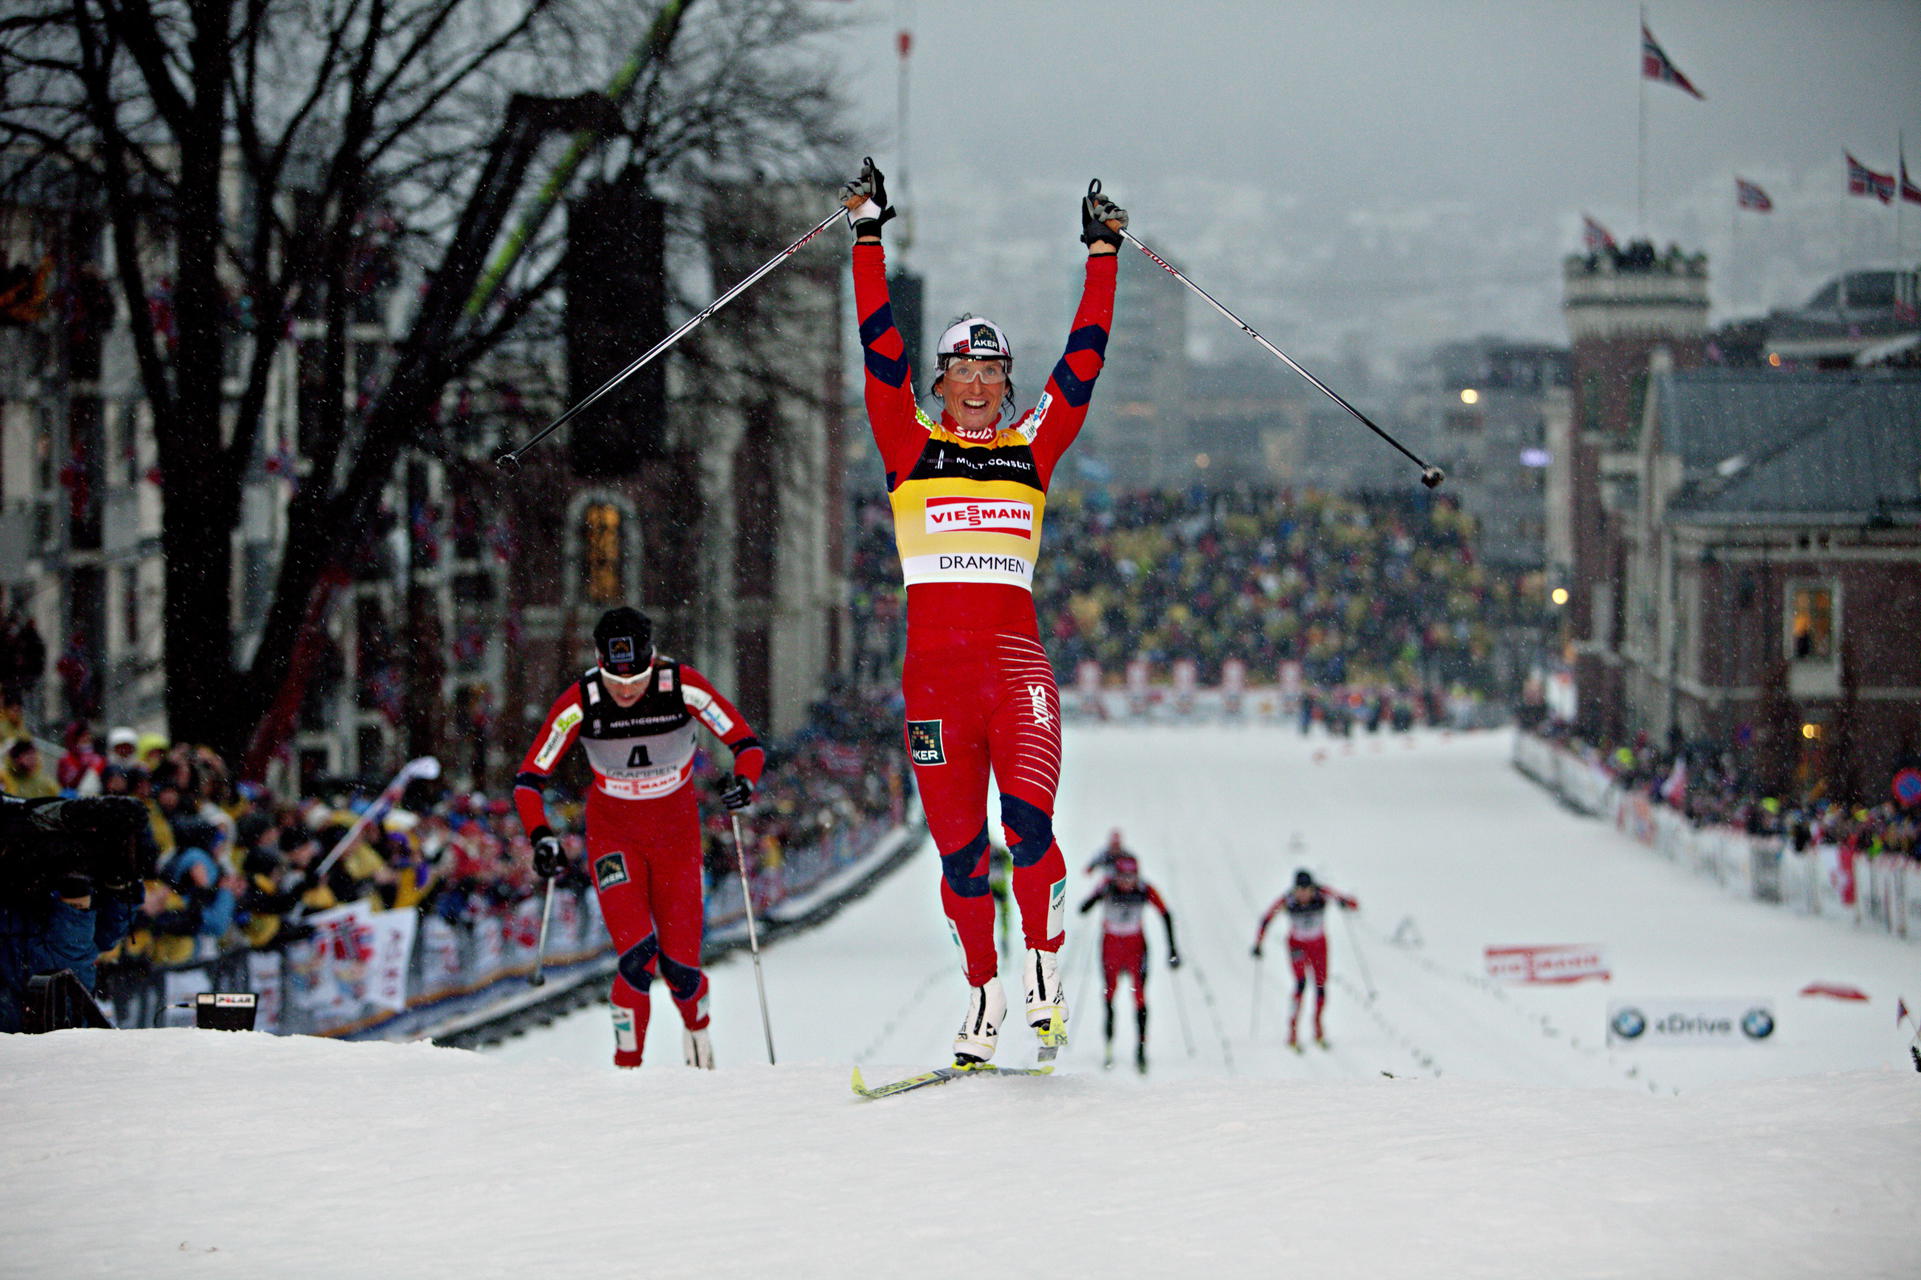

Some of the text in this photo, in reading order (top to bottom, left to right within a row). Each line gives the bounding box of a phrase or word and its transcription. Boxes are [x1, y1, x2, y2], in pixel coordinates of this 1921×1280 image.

[973, 339, 998, 349] AKER
[931, 505, 1031, 526] VIESSMANN
[939, 555, 1025, 574] DRAMMEN
[627, 744, 652, 768] 4
